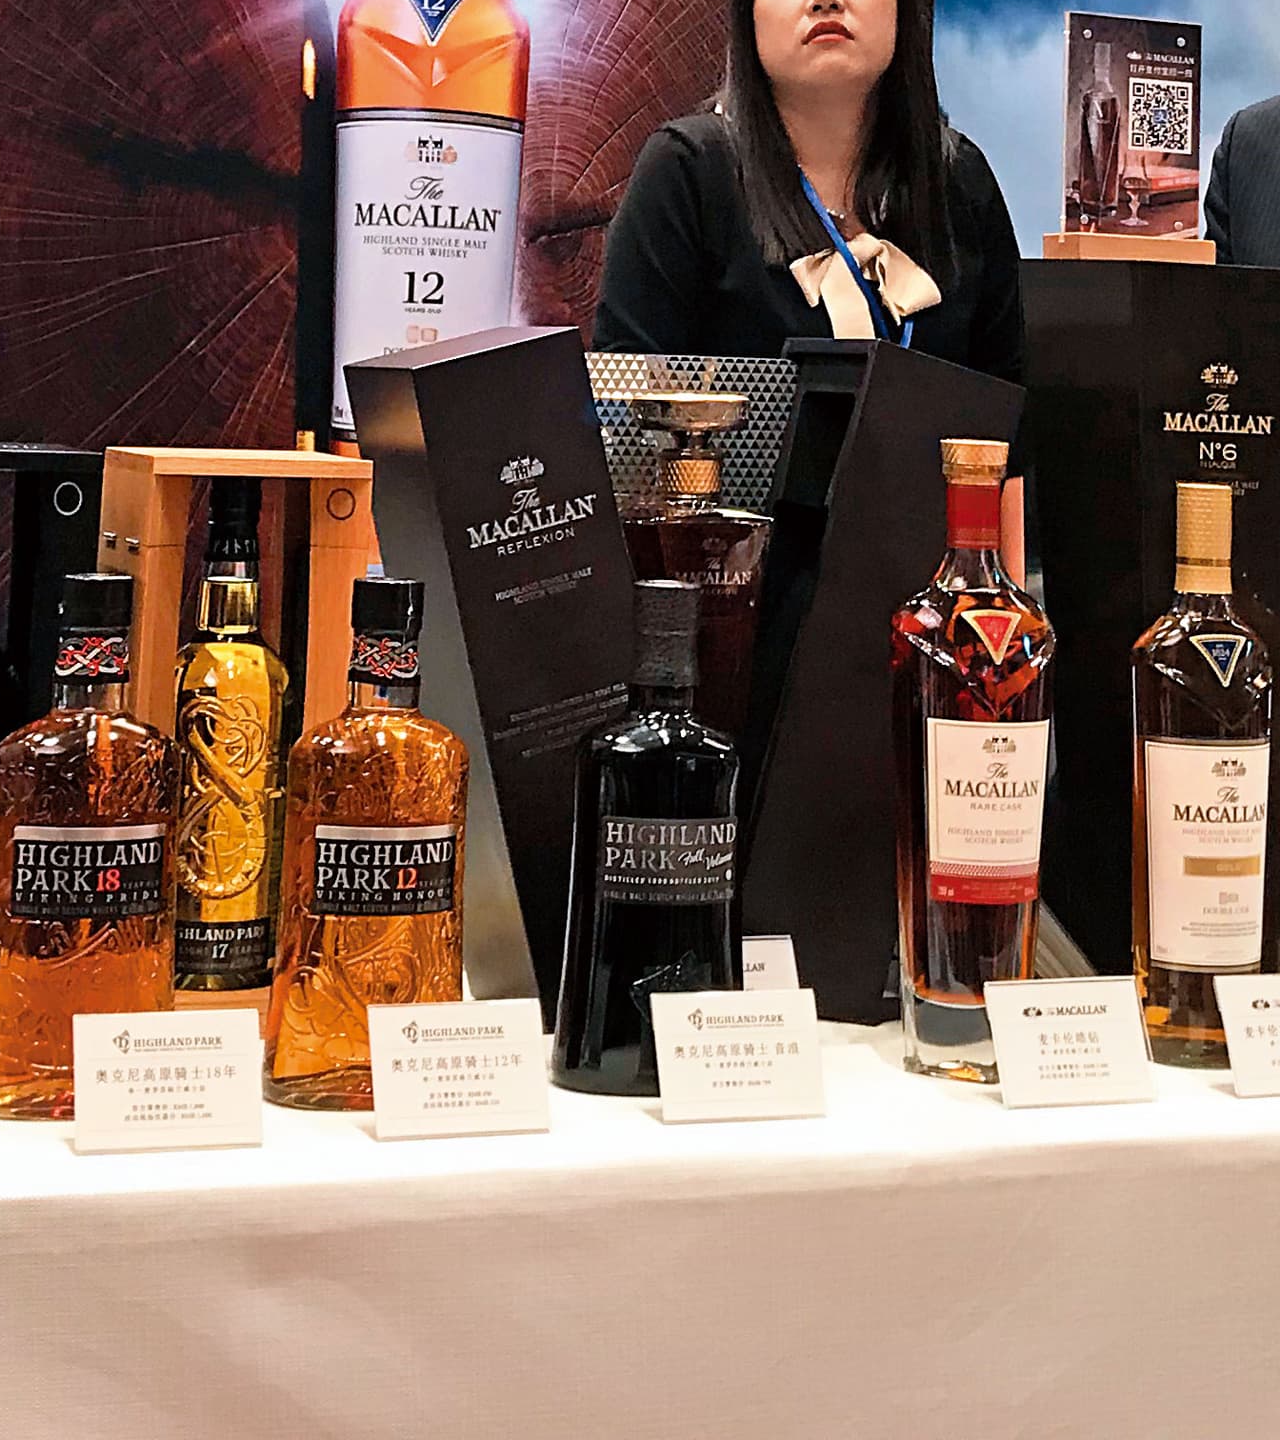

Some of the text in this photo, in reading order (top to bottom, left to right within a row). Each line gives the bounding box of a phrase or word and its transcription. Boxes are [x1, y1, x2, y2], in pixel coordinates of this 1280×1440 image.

[404, 175, 445, 201] The
[354, 203, 499, 233] MACALLAN
[363, 235, 488, 250] HIGHLAND SINGLE MALT
[382, 246, 469, 259] SCOTCH WHISKY
[402, 271, 446, 305] 12
[1204, 393, 1230, 412] The
[1163, 412, 1273, 435] MACALLAN
[511, 487, 541, 515] The
[467, 494, 597, 549] MACALLAN
[497, 526, 576, 557] REFLEXION
[986, 762, 1009, 780] The
[944, 779, 1039, 799] MACALLAN
[1217, 786, 1240, 804] The
[970, 803, 998, 812] RARE
[606, 822, 736, 847] HIGHLAND
[17, 841, 162, 867] HIGHLAND
[318, 841, 453, 866] HIGHLAND
[604, 846, 676, 873] PARK
[15, 867, 93, 895] PARK
[96, 868, 121, 892] 18
[316, 866, 418, 894] PARK 12
[15, 891, 95, 904] VIKING
[316, 890, 383, 902] VIKING
[211, 943, 229, 959] 17
[706, 1013, 785, 1025] HIGHLAND PARK
[1056, 1005, 1108, 1016] MACALLAN
[421, 1025, 505, 1038] HIGHLAND PARK
[133, 1036, 223, 1048] HIGHLAND PARK
